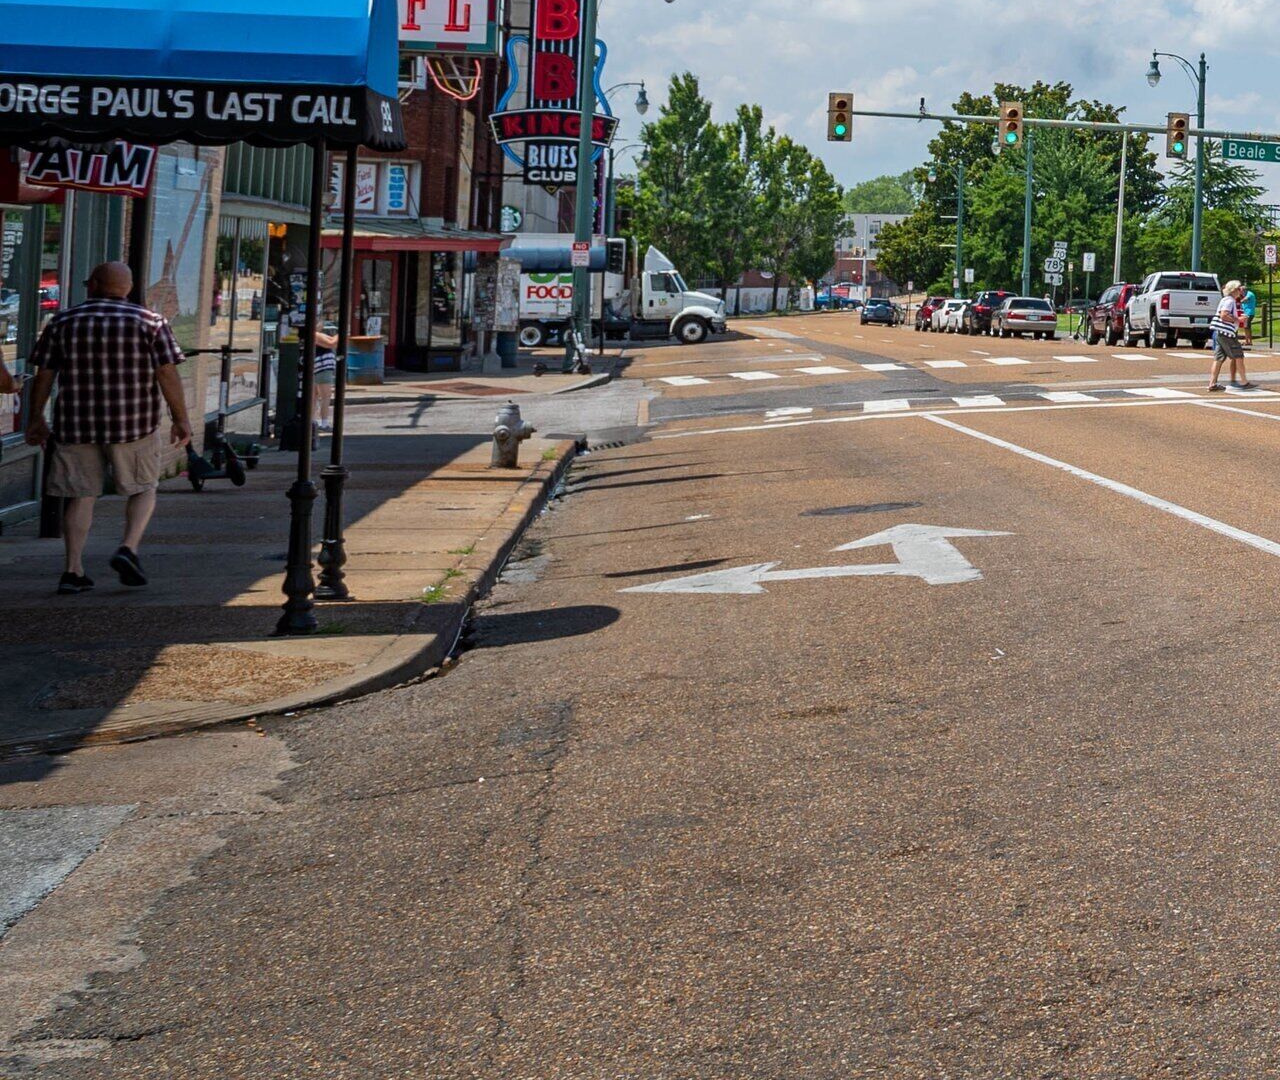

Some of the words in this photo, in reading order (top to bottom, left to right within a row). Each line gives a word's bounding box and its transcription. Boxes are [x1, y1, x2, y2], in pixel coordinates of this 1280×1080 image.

[90, 87, 194, 119] PAUL'S
[206, 90, 282, 122] LAST
[291, 95, 357, 126] CALL
[527, 143, 578, 169] BLUES
[1228, 142, 1266, 159] Beale
[27, 139, 155, 188] ATM
[527, 169, 577, 182] CLUB
[1055, 250, 1065, 258] 70
[1046, 260, 1059, 270] 78
